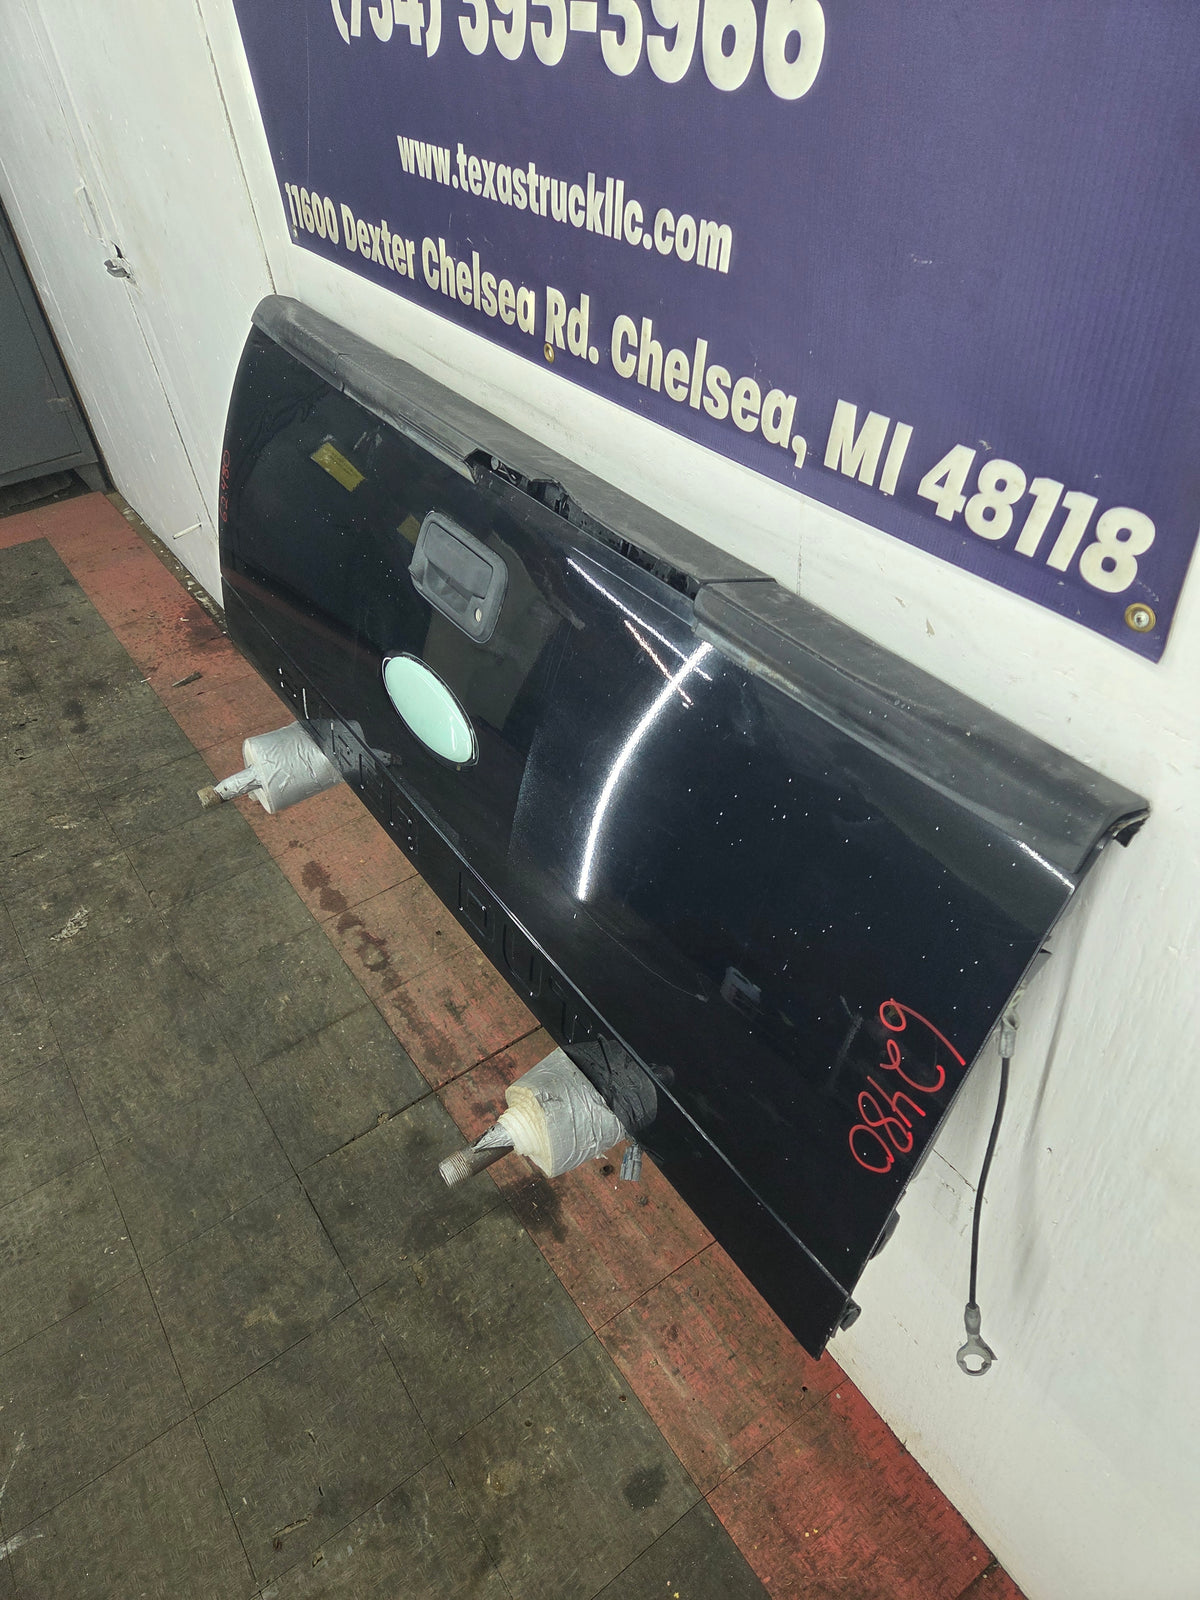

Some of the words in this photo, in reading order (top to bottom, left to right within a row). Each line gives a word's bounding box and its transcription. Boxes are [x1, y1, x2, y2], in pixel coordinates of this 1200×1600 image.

[396, 134, 733, 275] www.texastruckllc.com
[284, 182, 340, 245] 11600
[340, 202, 416, 280] Dexter
[421, 236, 536, 336] Chelsea
[544, 285, 600, 365] Rd.
[611, 314, 808, 470] Chelsea,
[823, 398, 914, 496] MI
[917, 443, 1156, 594] 48118
[848, 997, 966, 1174] 62480
